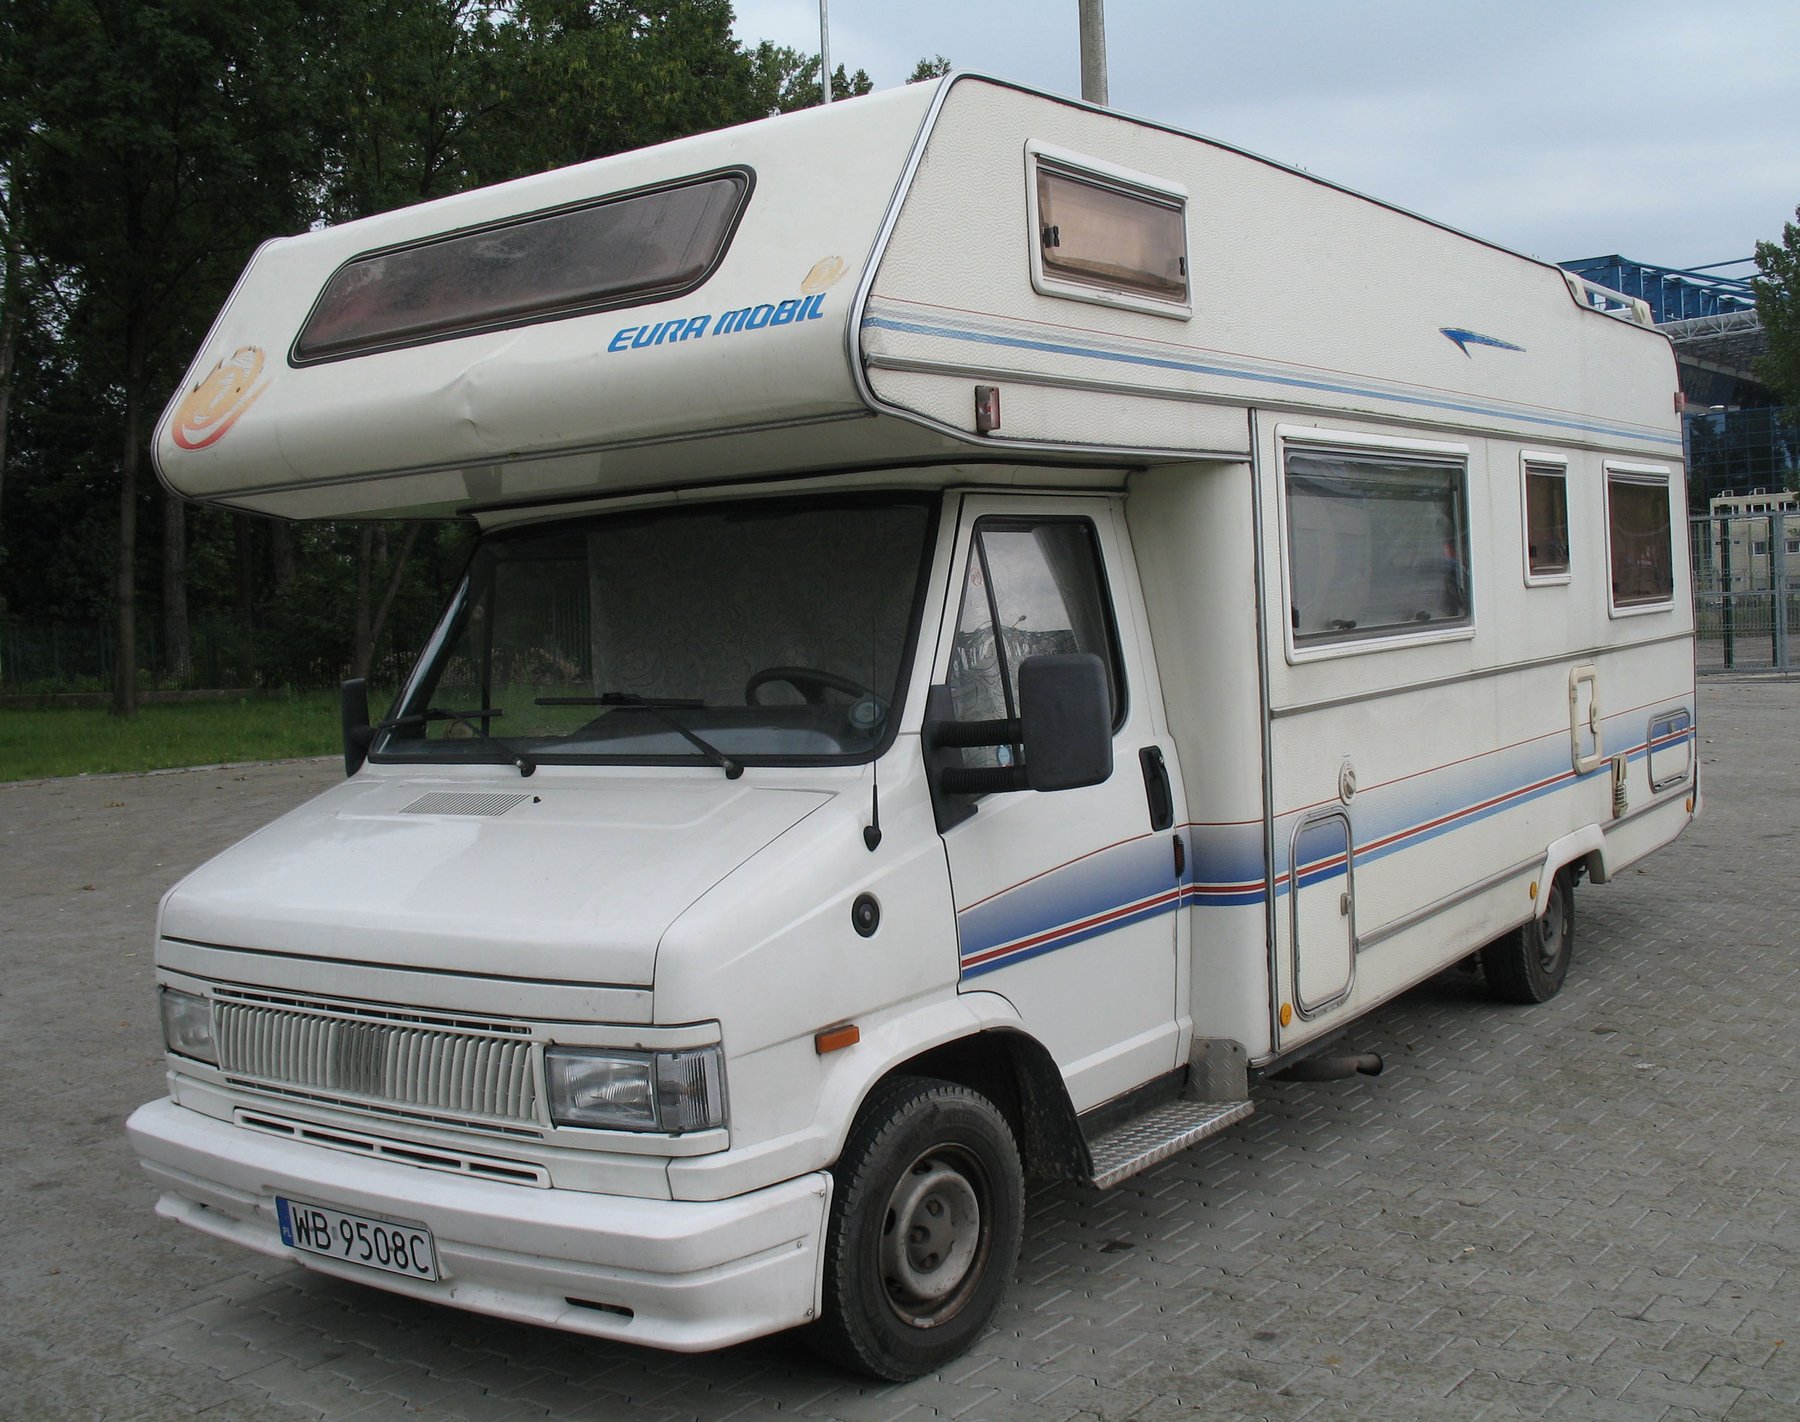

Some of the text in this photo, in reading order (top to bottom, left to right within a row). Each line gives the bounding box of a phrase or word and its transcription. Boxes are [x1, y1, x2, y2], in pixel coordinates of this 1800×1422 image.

[607, 293, 826, 352] EURA MOBIL
[292, 1206, 429, 1273] WB 9508C
